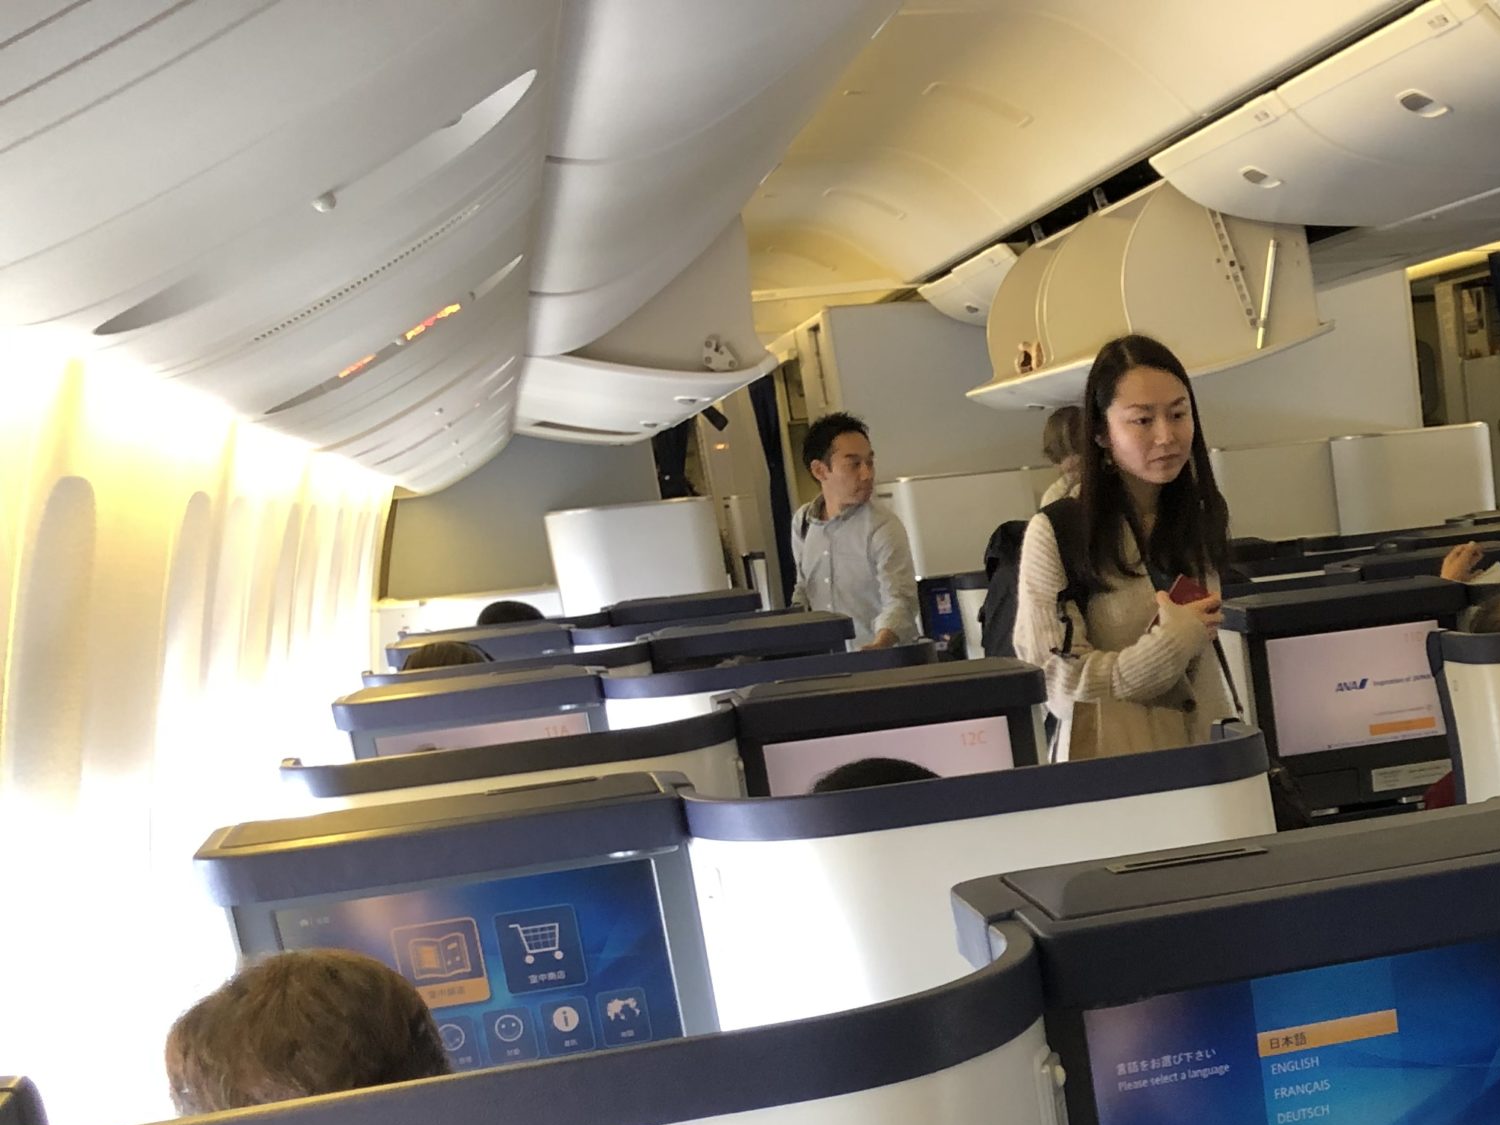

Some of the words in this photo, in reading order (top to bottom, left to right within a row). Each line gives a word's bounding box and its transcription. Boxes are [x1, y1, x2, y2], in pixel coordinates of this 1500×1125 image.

[1335, 680, 1361, 693] ANA
[961, 729, 987, 747] 12C
[1269, 1032, 1307, 1050] 日本語
[1271, 1056, 1320, 1075] ENGLISH
[1118, 1078, 1148, 1092] Please
[1150, 1072, 1178, 1086] select
[1188, 1063, 1230, 1079] language
[1273, 1079, 1331, 1100] FRANÇAIS
[1277, 1104, 1330, 1125] DEUTSCH
